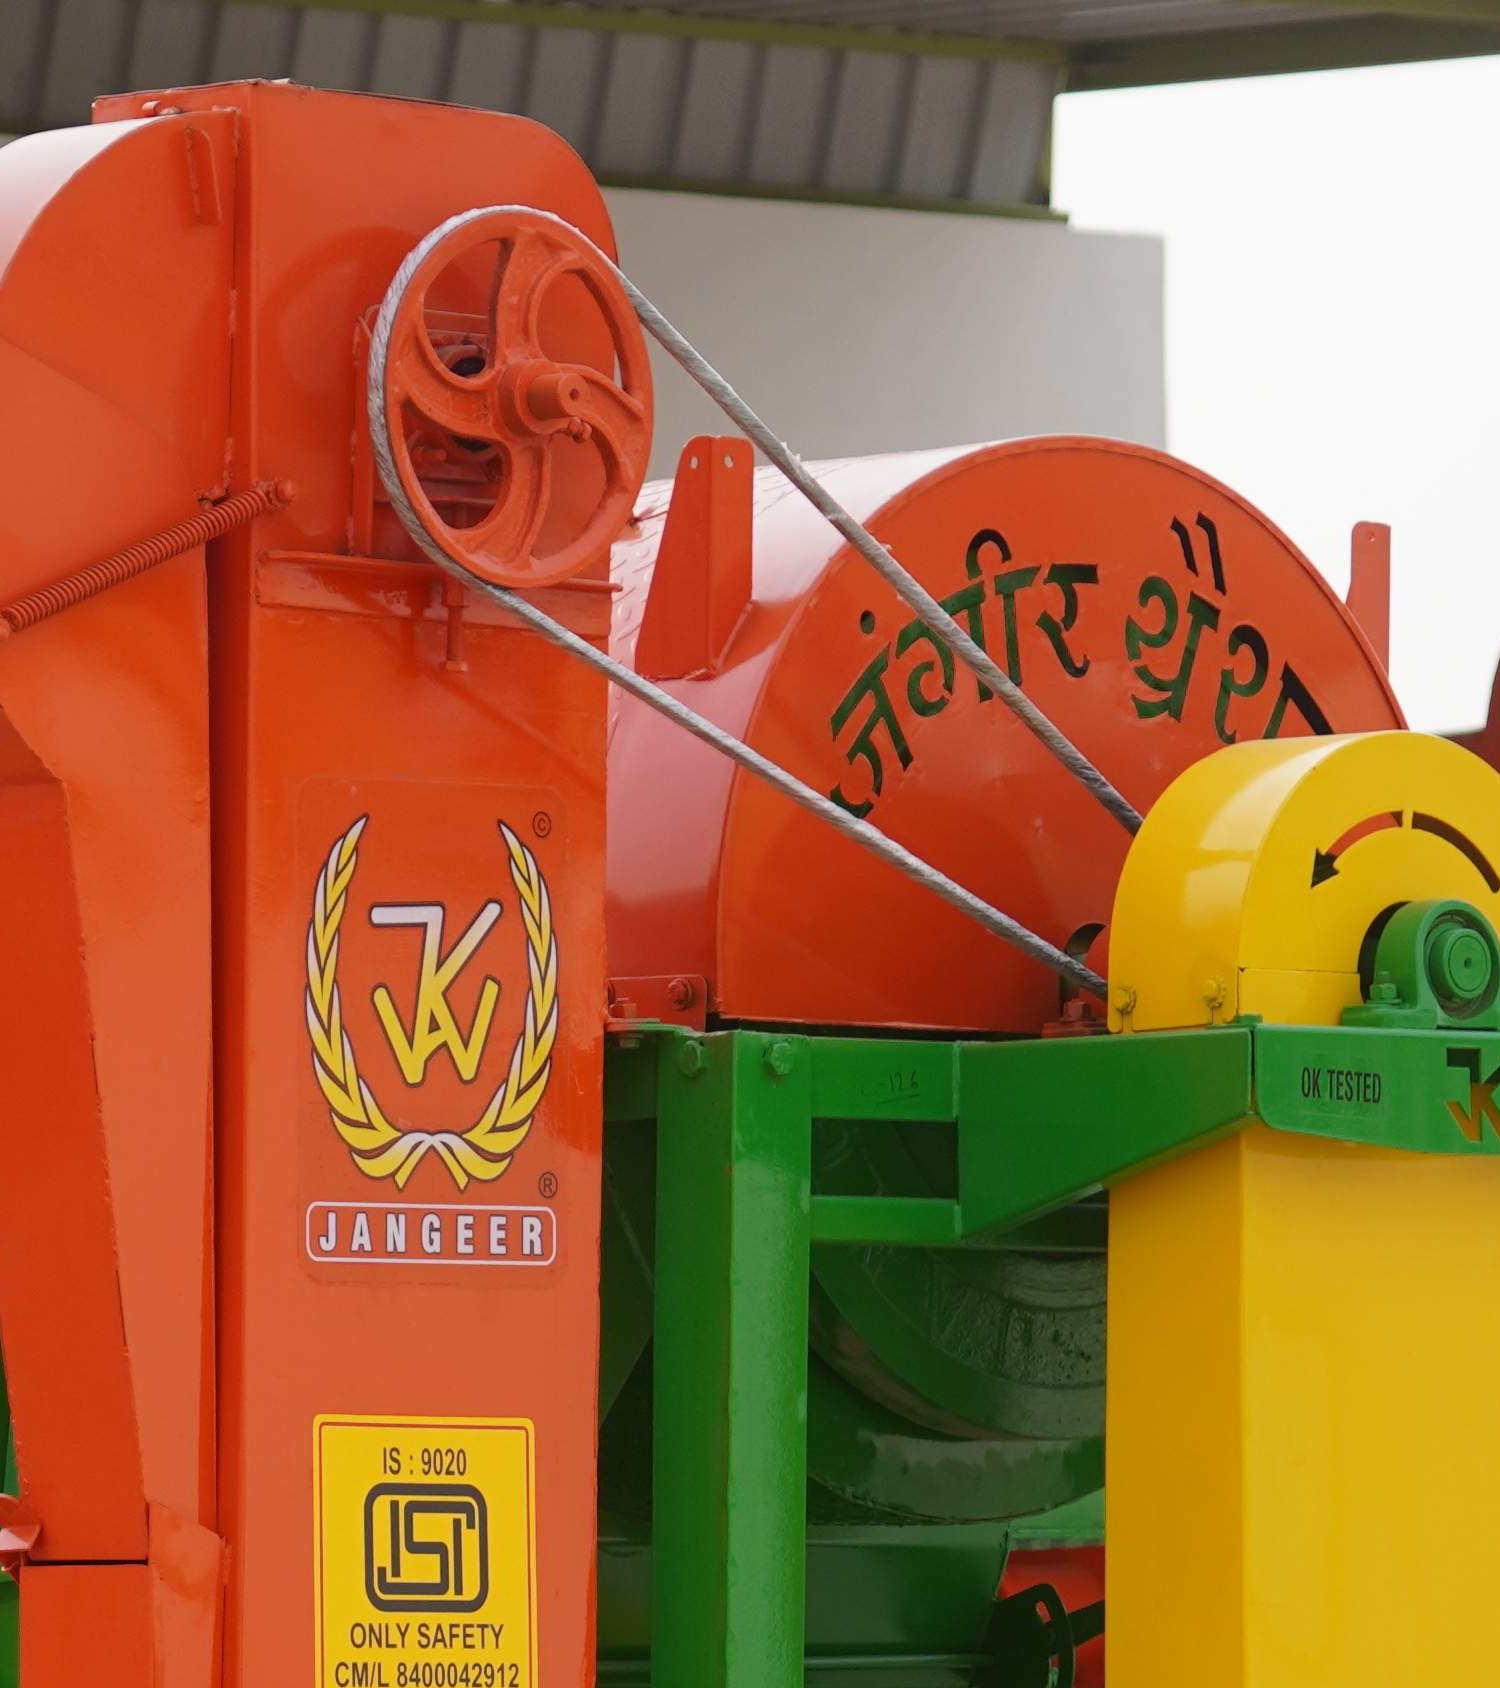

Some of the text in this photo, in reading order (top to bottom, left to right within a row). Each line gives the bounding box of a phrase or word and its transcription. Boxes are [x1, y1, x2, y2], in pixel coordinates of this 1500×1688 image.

[1302, 1067, 1381, 1104] OK TESTED
[319, 1211, 544, 1256] JANGEER
[383, 1447, 401, 1475] IS
[421, 1448, 467, 1476] 9020
[350, 1623, 504, 1650] ONLY SAFETY
[335, 1661, 519, 1688] CM/L 8400042912
